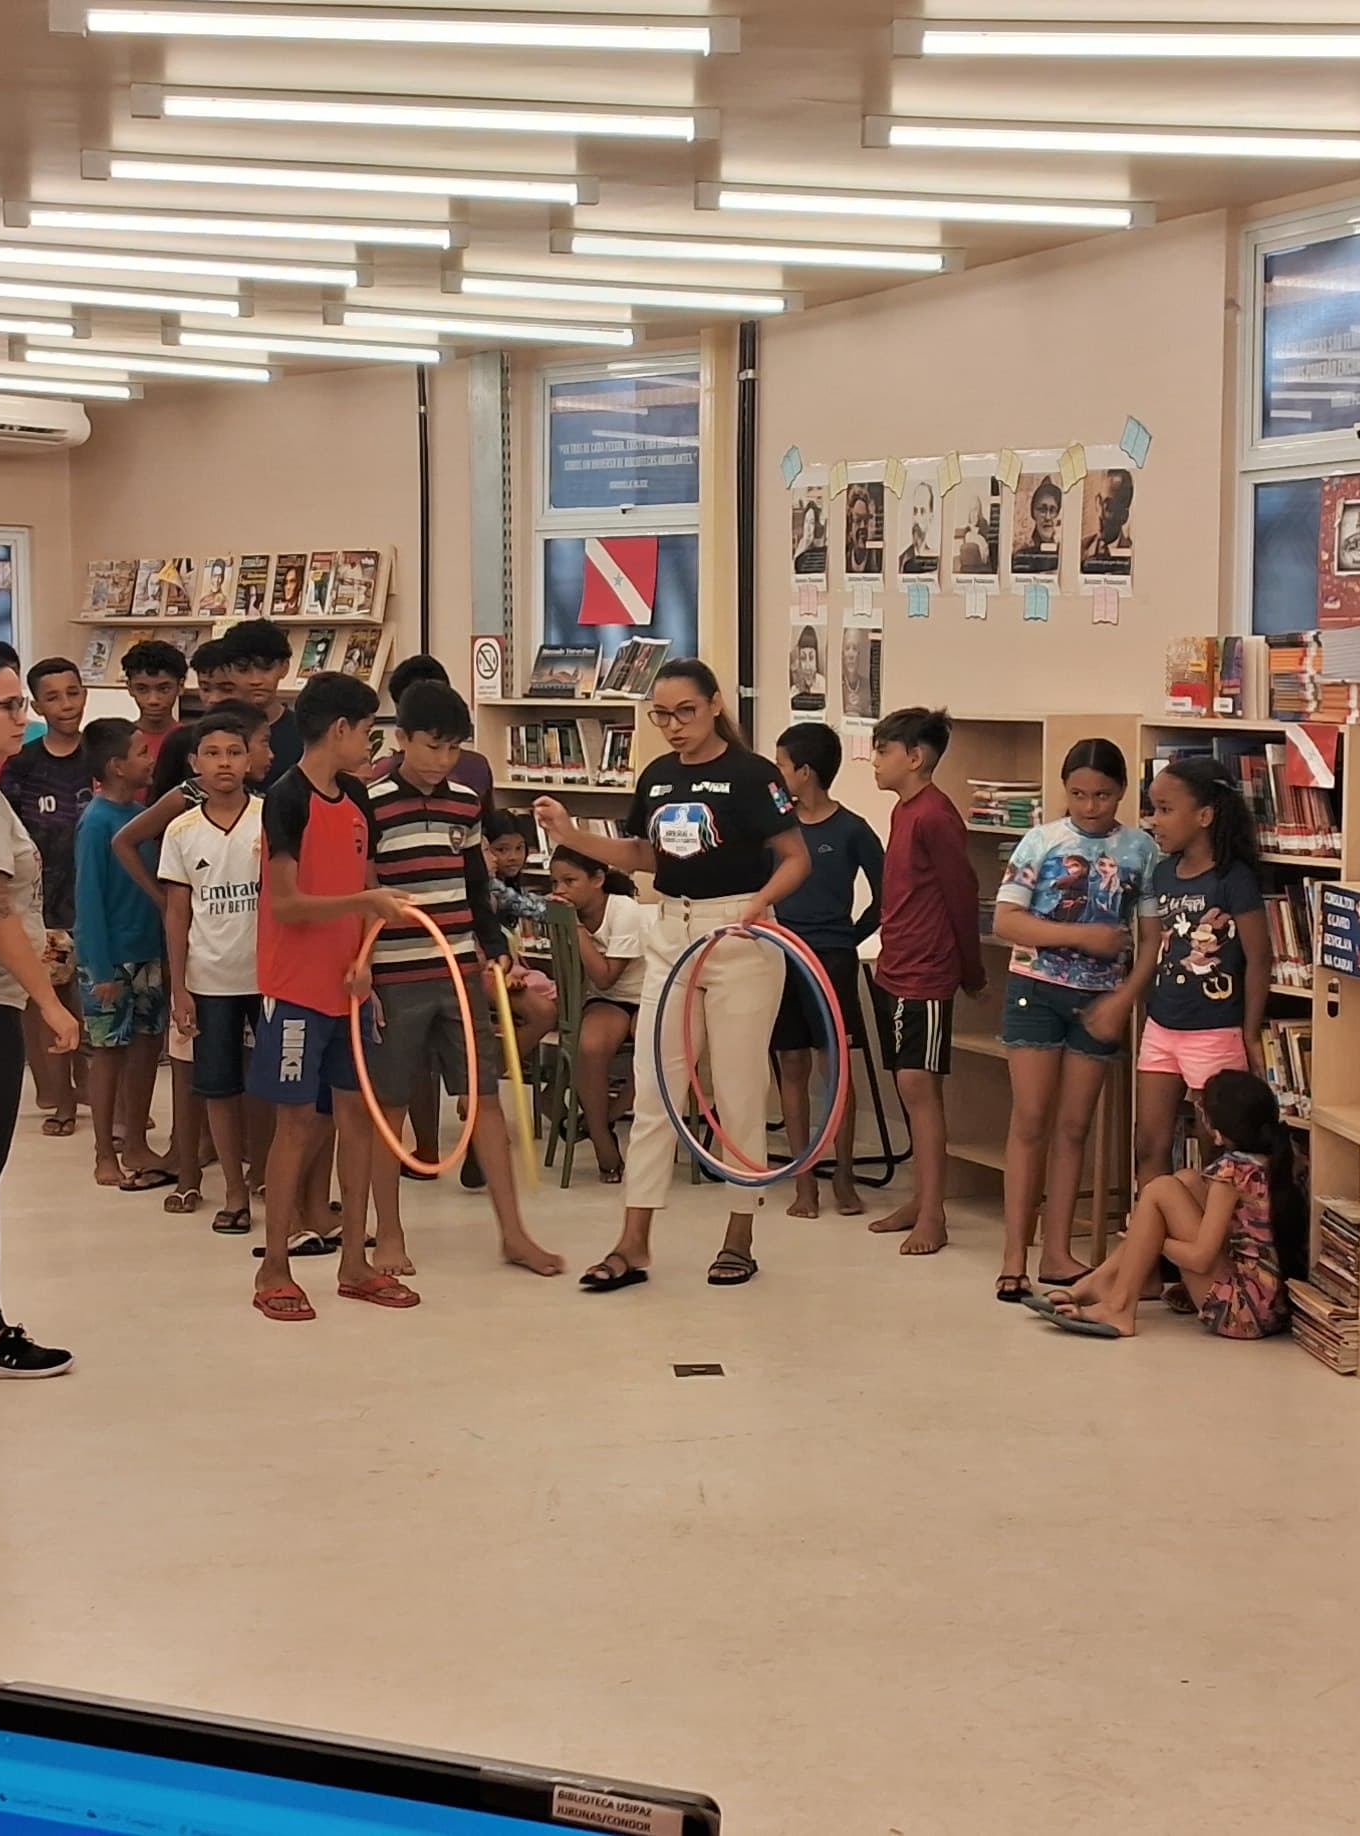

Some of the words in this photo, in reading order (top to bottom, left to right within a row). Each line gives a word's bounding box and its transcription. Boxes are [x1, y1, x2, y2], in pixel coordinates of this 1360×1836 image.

[209, 902, 225, 916] FLY
[279, 1019, 306, 1083] NIKE
[558, 1790, 615, 1811] BIBLIOTECA
